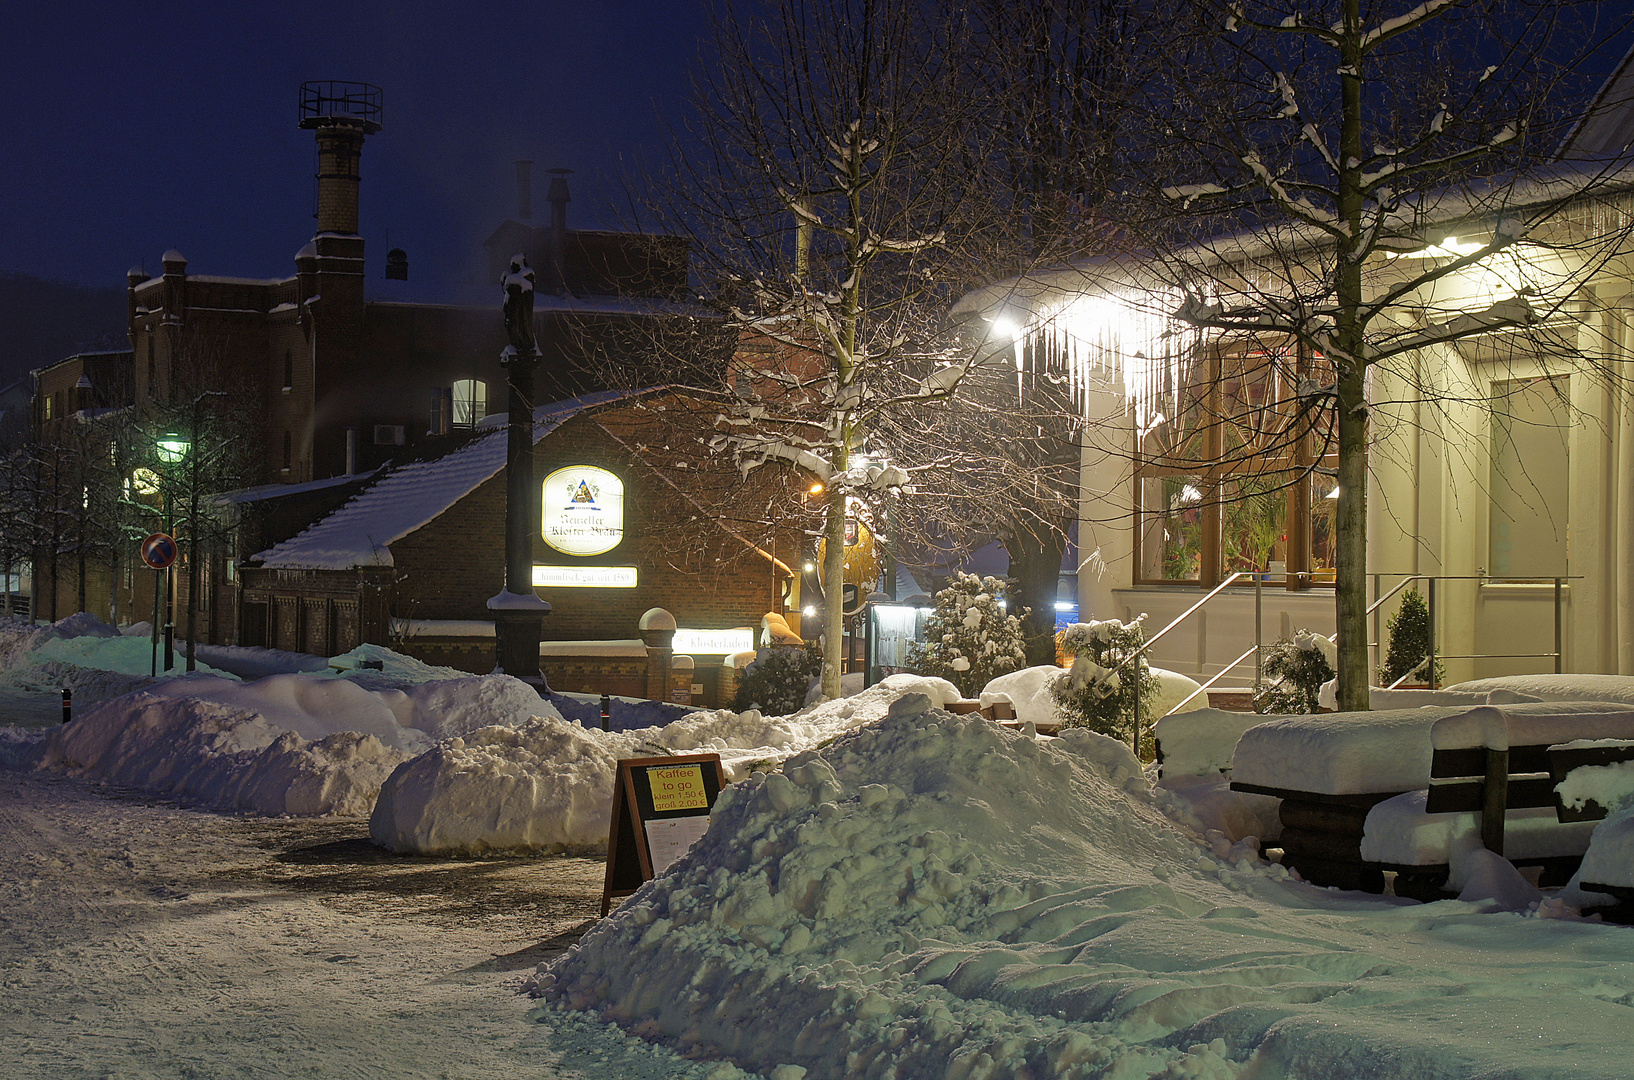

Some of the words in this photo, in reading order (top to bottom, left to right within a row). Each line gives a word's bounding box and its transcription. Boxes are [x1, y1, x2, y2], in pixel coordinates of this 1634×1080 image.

[583, 574, 594, 583] gut
[613, 573, 630, 582] 1589
[691, 636, 749, 648] Klosterladen
[656, 769, 694, 779] Kaffee
[663, 782, 674, 790] to
[677, 781, 692, 792] go
[654, 792, 675, 800] klein
[678, 791, 696, 799] 1,50
[655, 800, 677, 809] groß
[700, 798, 706, 806] €
